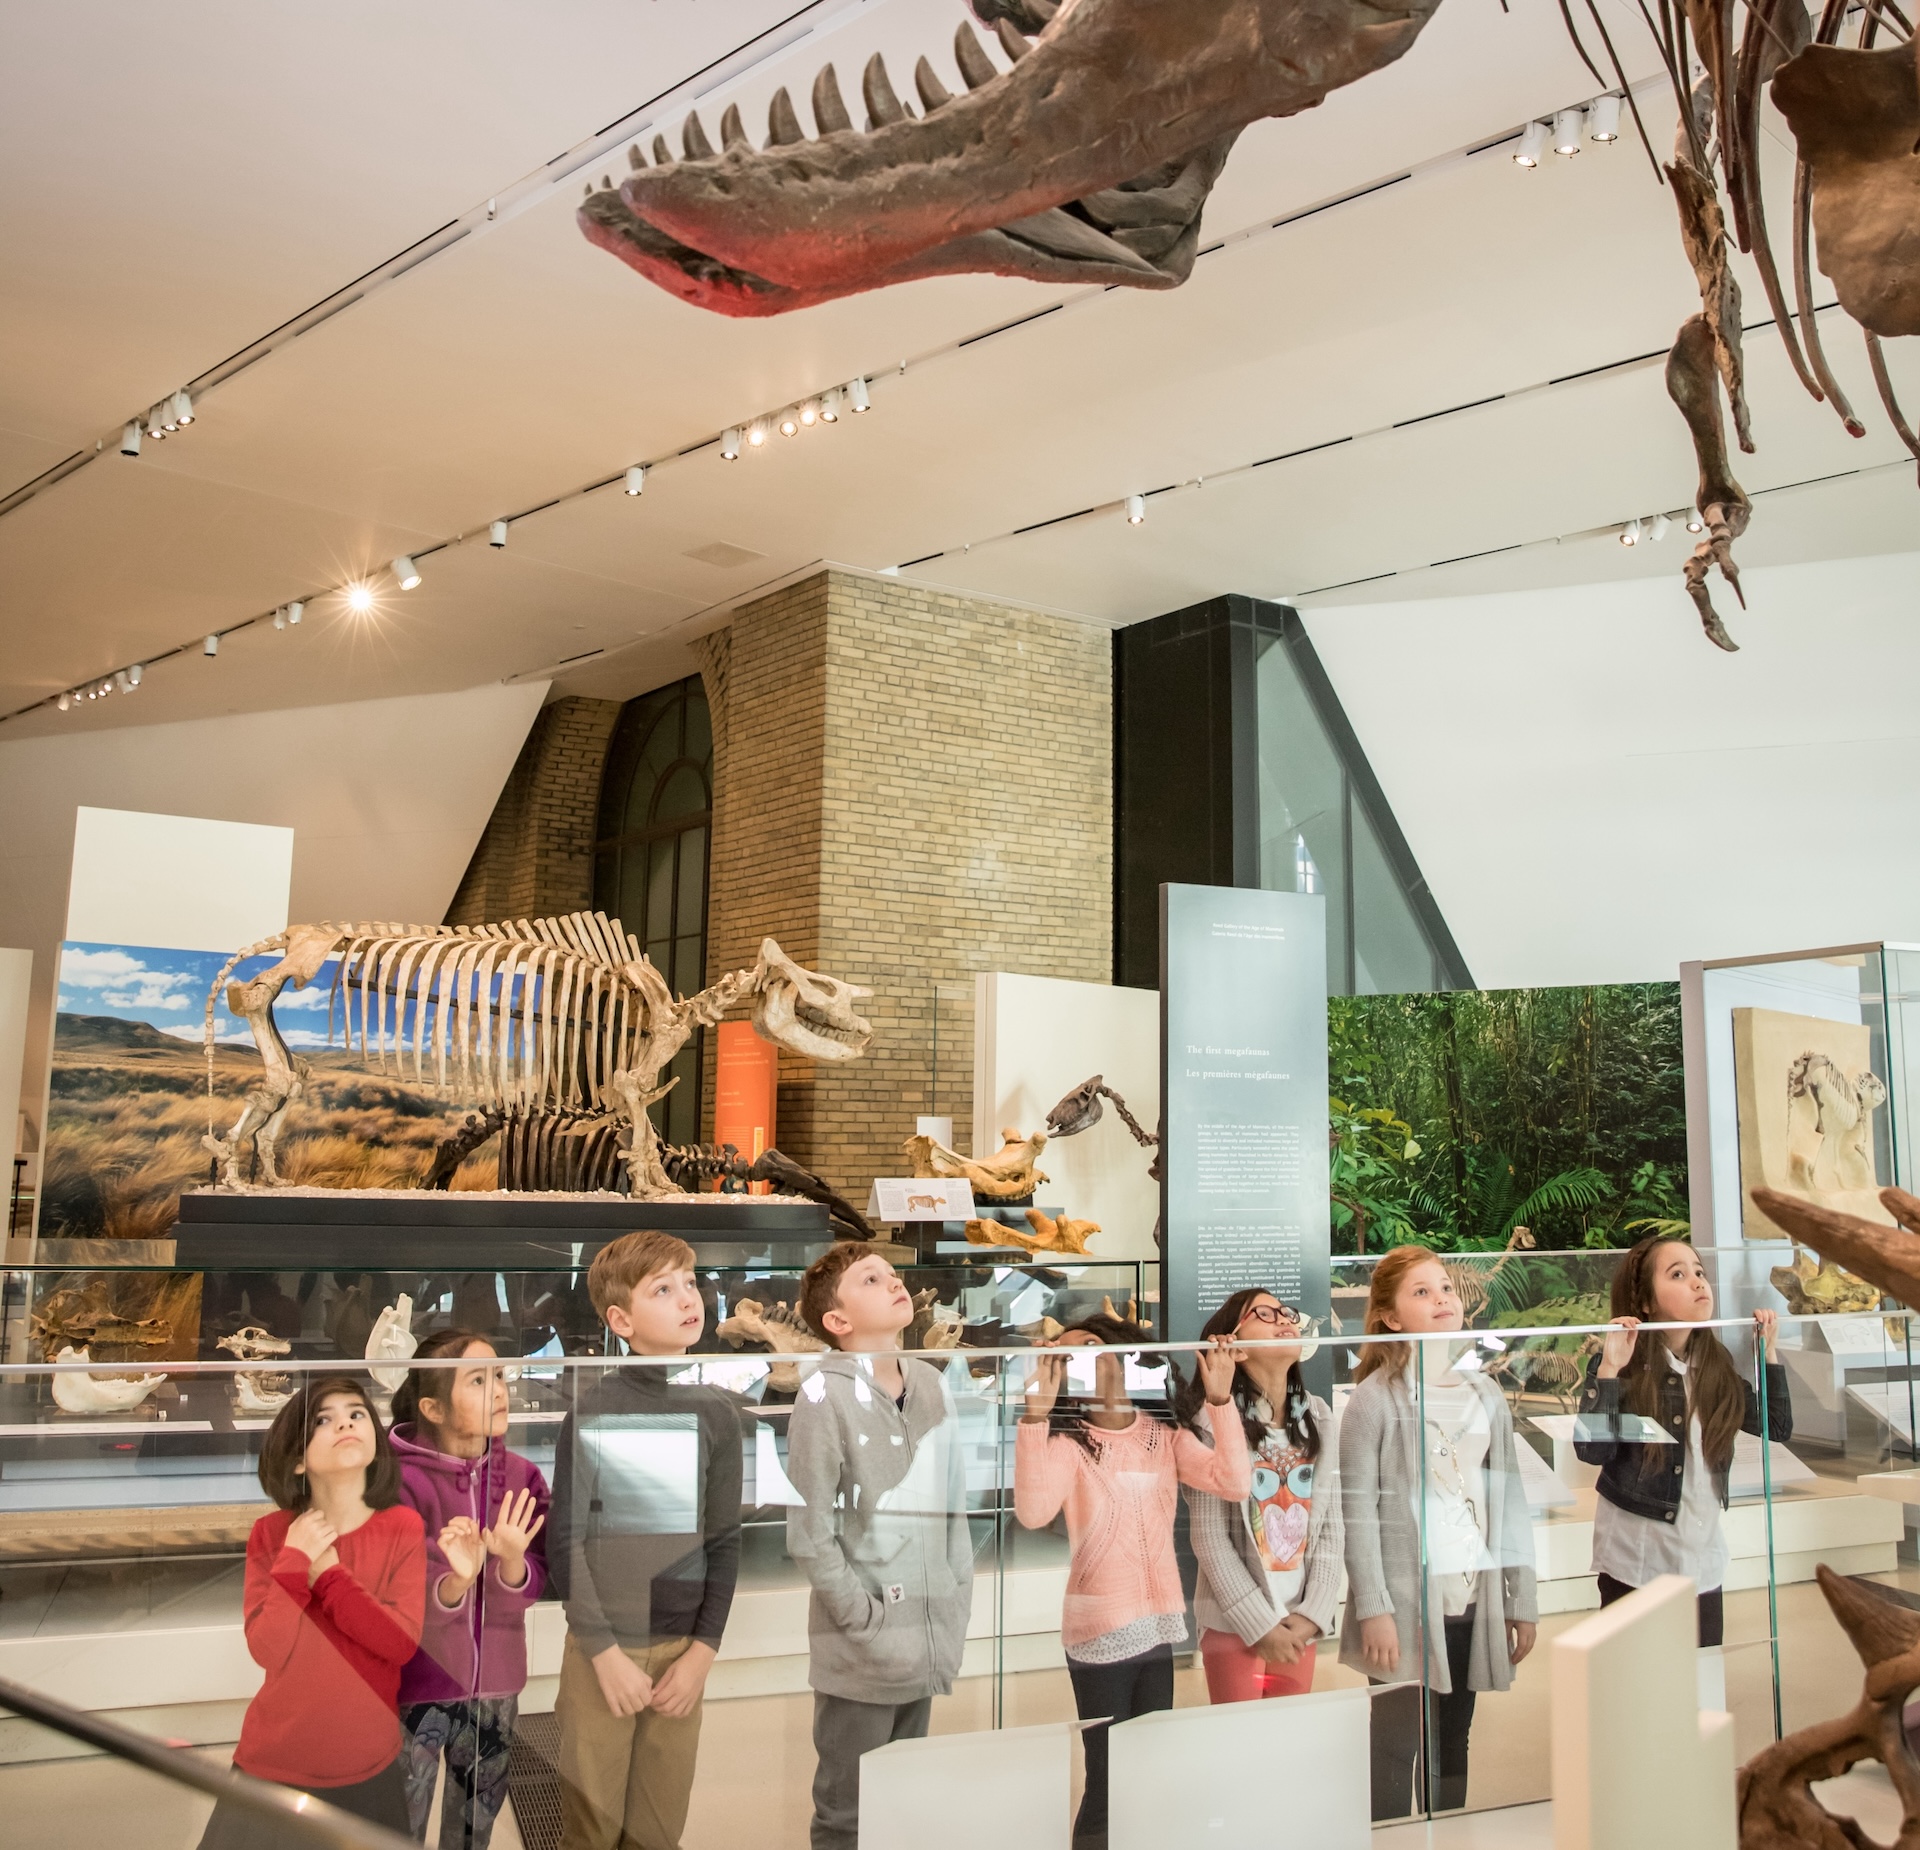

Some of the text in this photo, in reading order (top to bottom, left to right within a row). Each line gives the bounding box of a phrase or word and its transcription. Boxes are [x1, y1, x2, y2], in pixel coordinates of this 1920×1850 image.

[1186, 1045, 1270, 1057] The first megafaunas
[1186, 1069, 1290, 1081] Les premières mégafaunes
